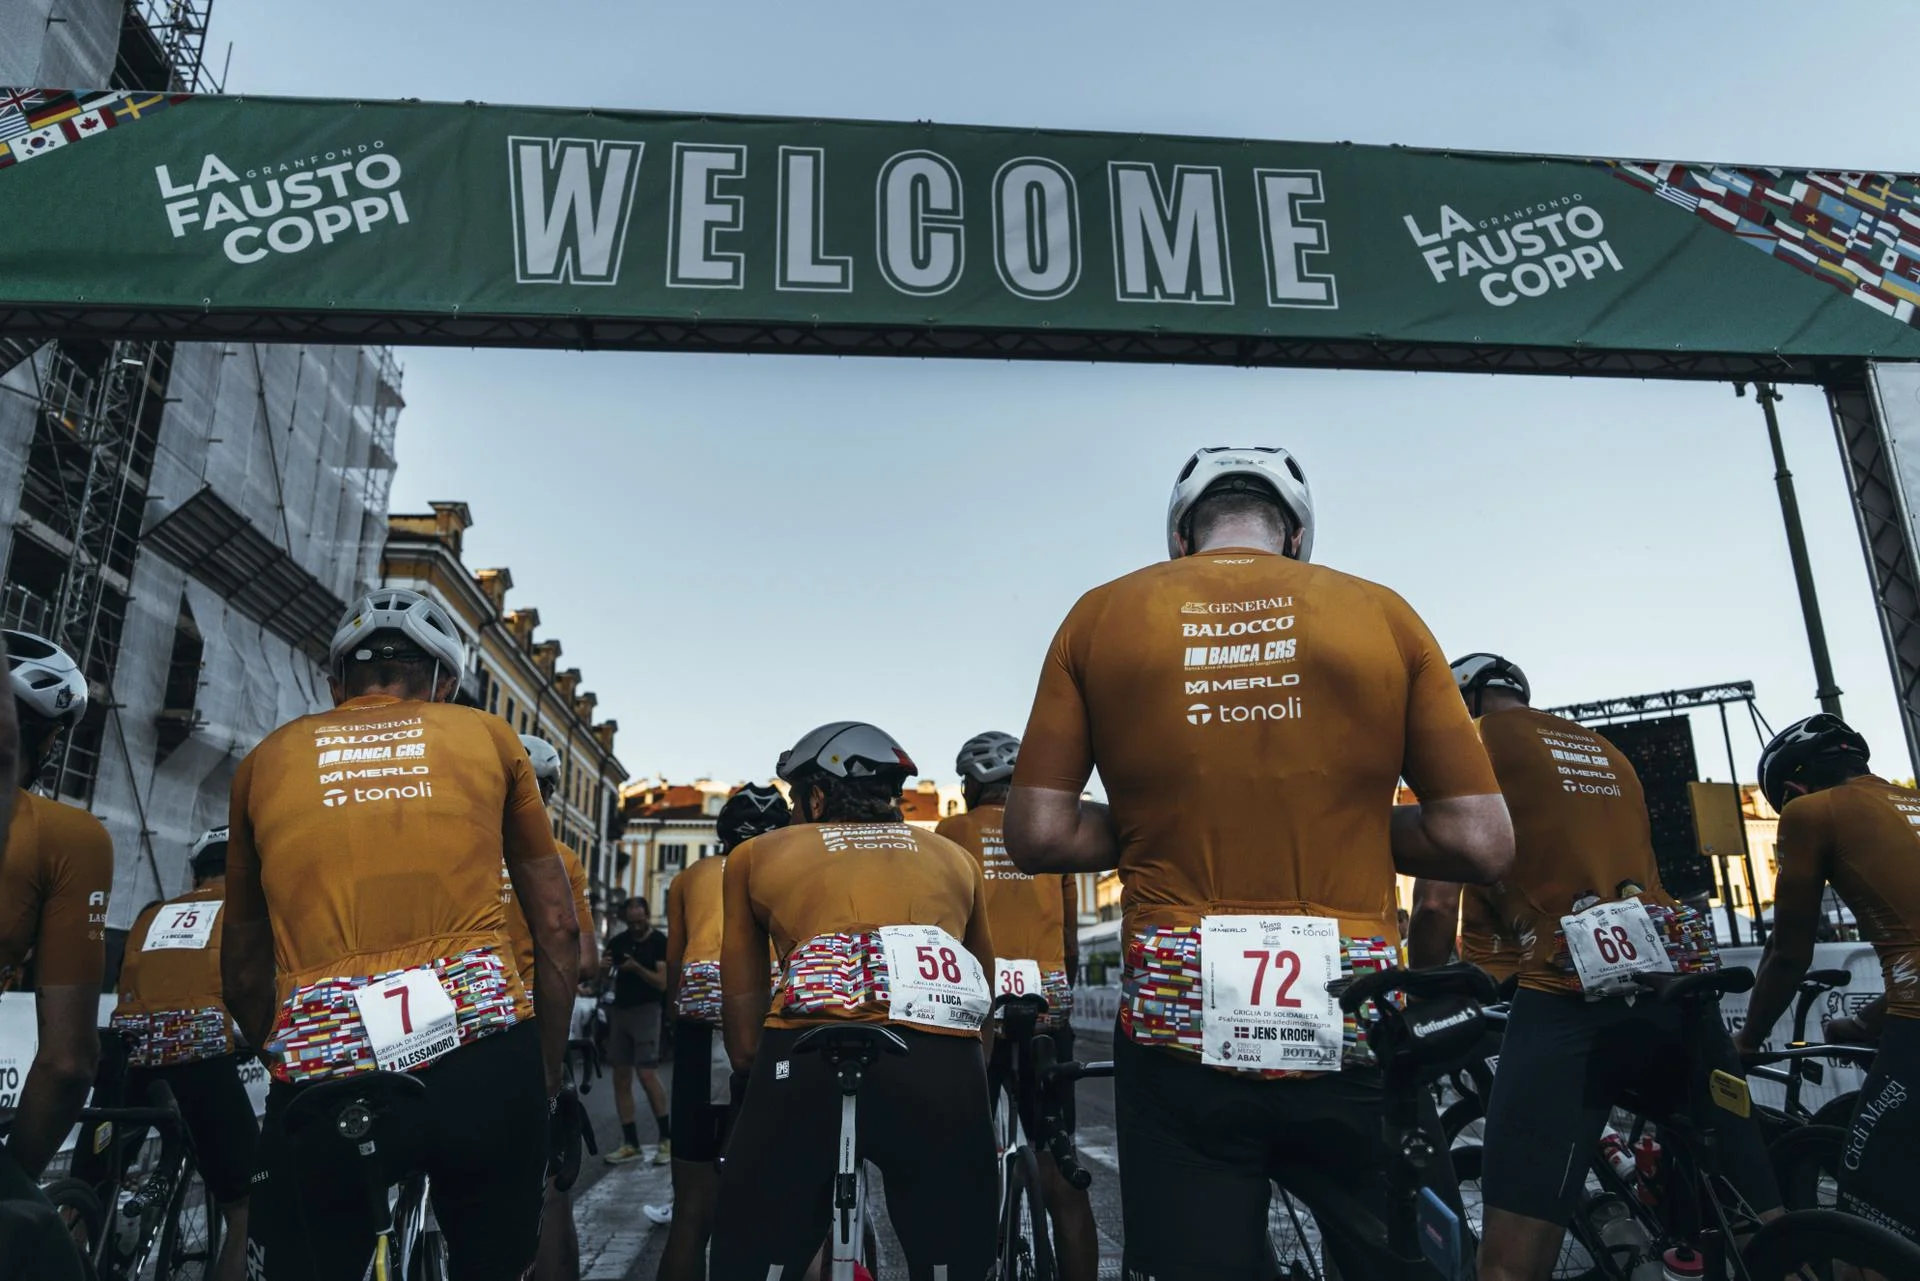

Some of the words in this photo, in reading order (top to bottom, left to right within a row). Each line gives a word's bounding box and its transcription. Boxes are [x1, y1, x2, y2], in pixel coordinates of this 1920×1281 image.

[246, 140, 385, 179] GRANFONDO
[154, 153, 240, 199] LA
[165, 153, 402, 238] FAUSTO
[508, 135, 1338, 309] WELCOME
[1479, 193, 1583, 229] GRANFONDO
[223, 190, 410, 264] COPPI
[1403, 204, 1476, 247] LA
[1422, 205, 1604, 283] FAUSTO
[1479, 240, 1624, 306] COPPI
[1208, 596, 1294, 614] GENERALI
[1182, 615, 1295, 637] BALOCCO
[1208, 643, 1260, 665] BANCA
[1264, 638, 1297, 661] CRS
[1212, 674, 1300, 691] MERLO
[1219, 697, 1302, 722] tonoli
[341, 717, 423, 732] GENERALI
[315, 728, 424, 747] BALOCCO
[1542, 737, 1602, 752] BALOCCO
[342, 747, 392, 761] BANCA
[395, 743, 426, 757] CRS
[1564, 751, 1592, 764] BANCA
[346, 766, 429, 779] MERLO
[1572, 769, 1616, 780] MERLO
[354, 781, 432, 802] tonoli
[1579, 782, 1621, 796] tonoli
[854, 842, 918, 852] tonoli
[171, 910, 200, 929] 75
[1303, 927, 1334, 936] tonoli
[1593, 925, 1637, 964] 68
[915, 946, 962, 984] 58
[1000, 970, 1024, 995] 36
[1243, 950, 1302, 1008] 72
[383, 985, 413, 1035] 7
[942, 994, 962, 1006] LUCA
[1252, 1026, 1277, 1040] JENS
[1280, 1027, 1315, 1042] KROGH
[377, 1042, 403, 1055] GRIGLIA
[397, 1035, 455, 1069] ALESSANDRO
[1237, 1054, 1261, 1062] ABAX
[1844, 1124, 1869, 1171] Cicli
[1860, 1074, 1908, 1128] Maggi
